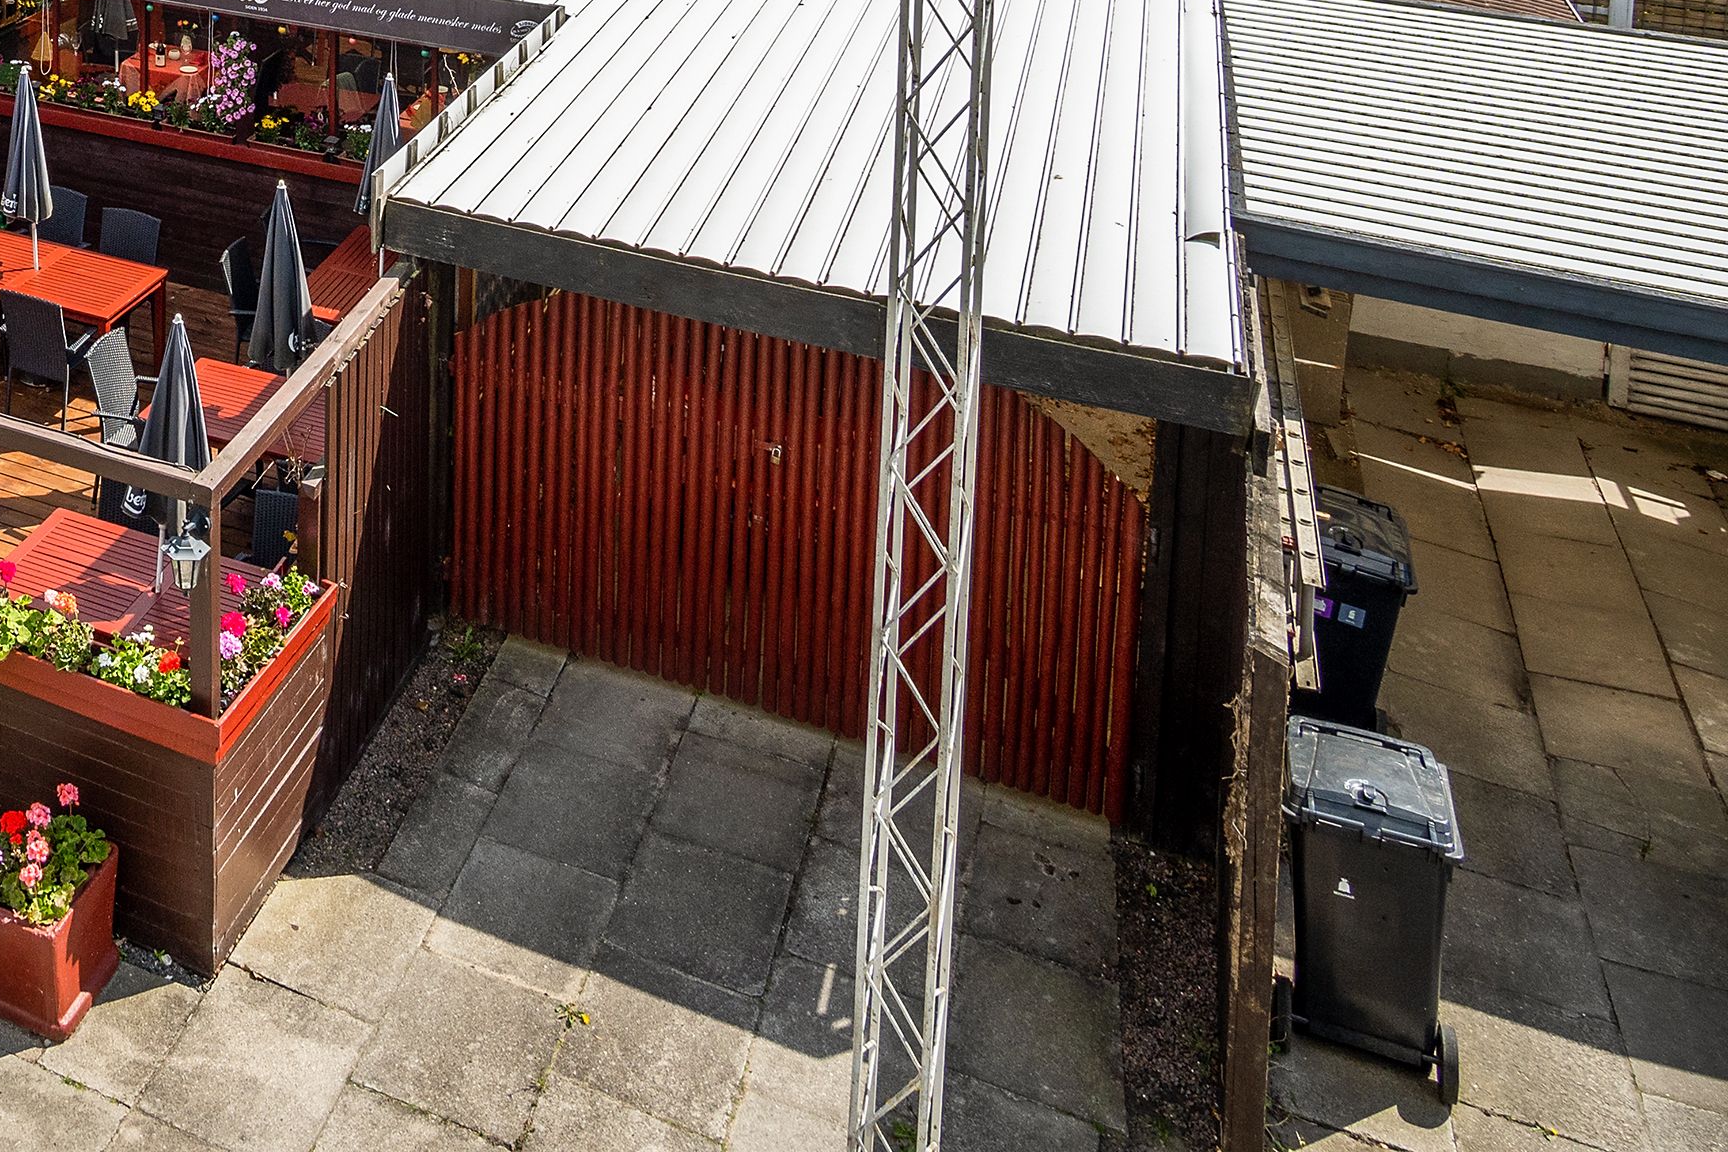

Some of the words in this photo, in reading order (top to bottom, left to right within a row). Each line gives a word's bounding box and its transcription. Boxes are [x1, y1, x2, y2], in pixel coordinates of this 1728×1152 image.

[328, 0, 352, 14] god
[352, 3, 376, 14] mad
[375, 8, 388, 21] og
[386, 7, 416, 23] glade
